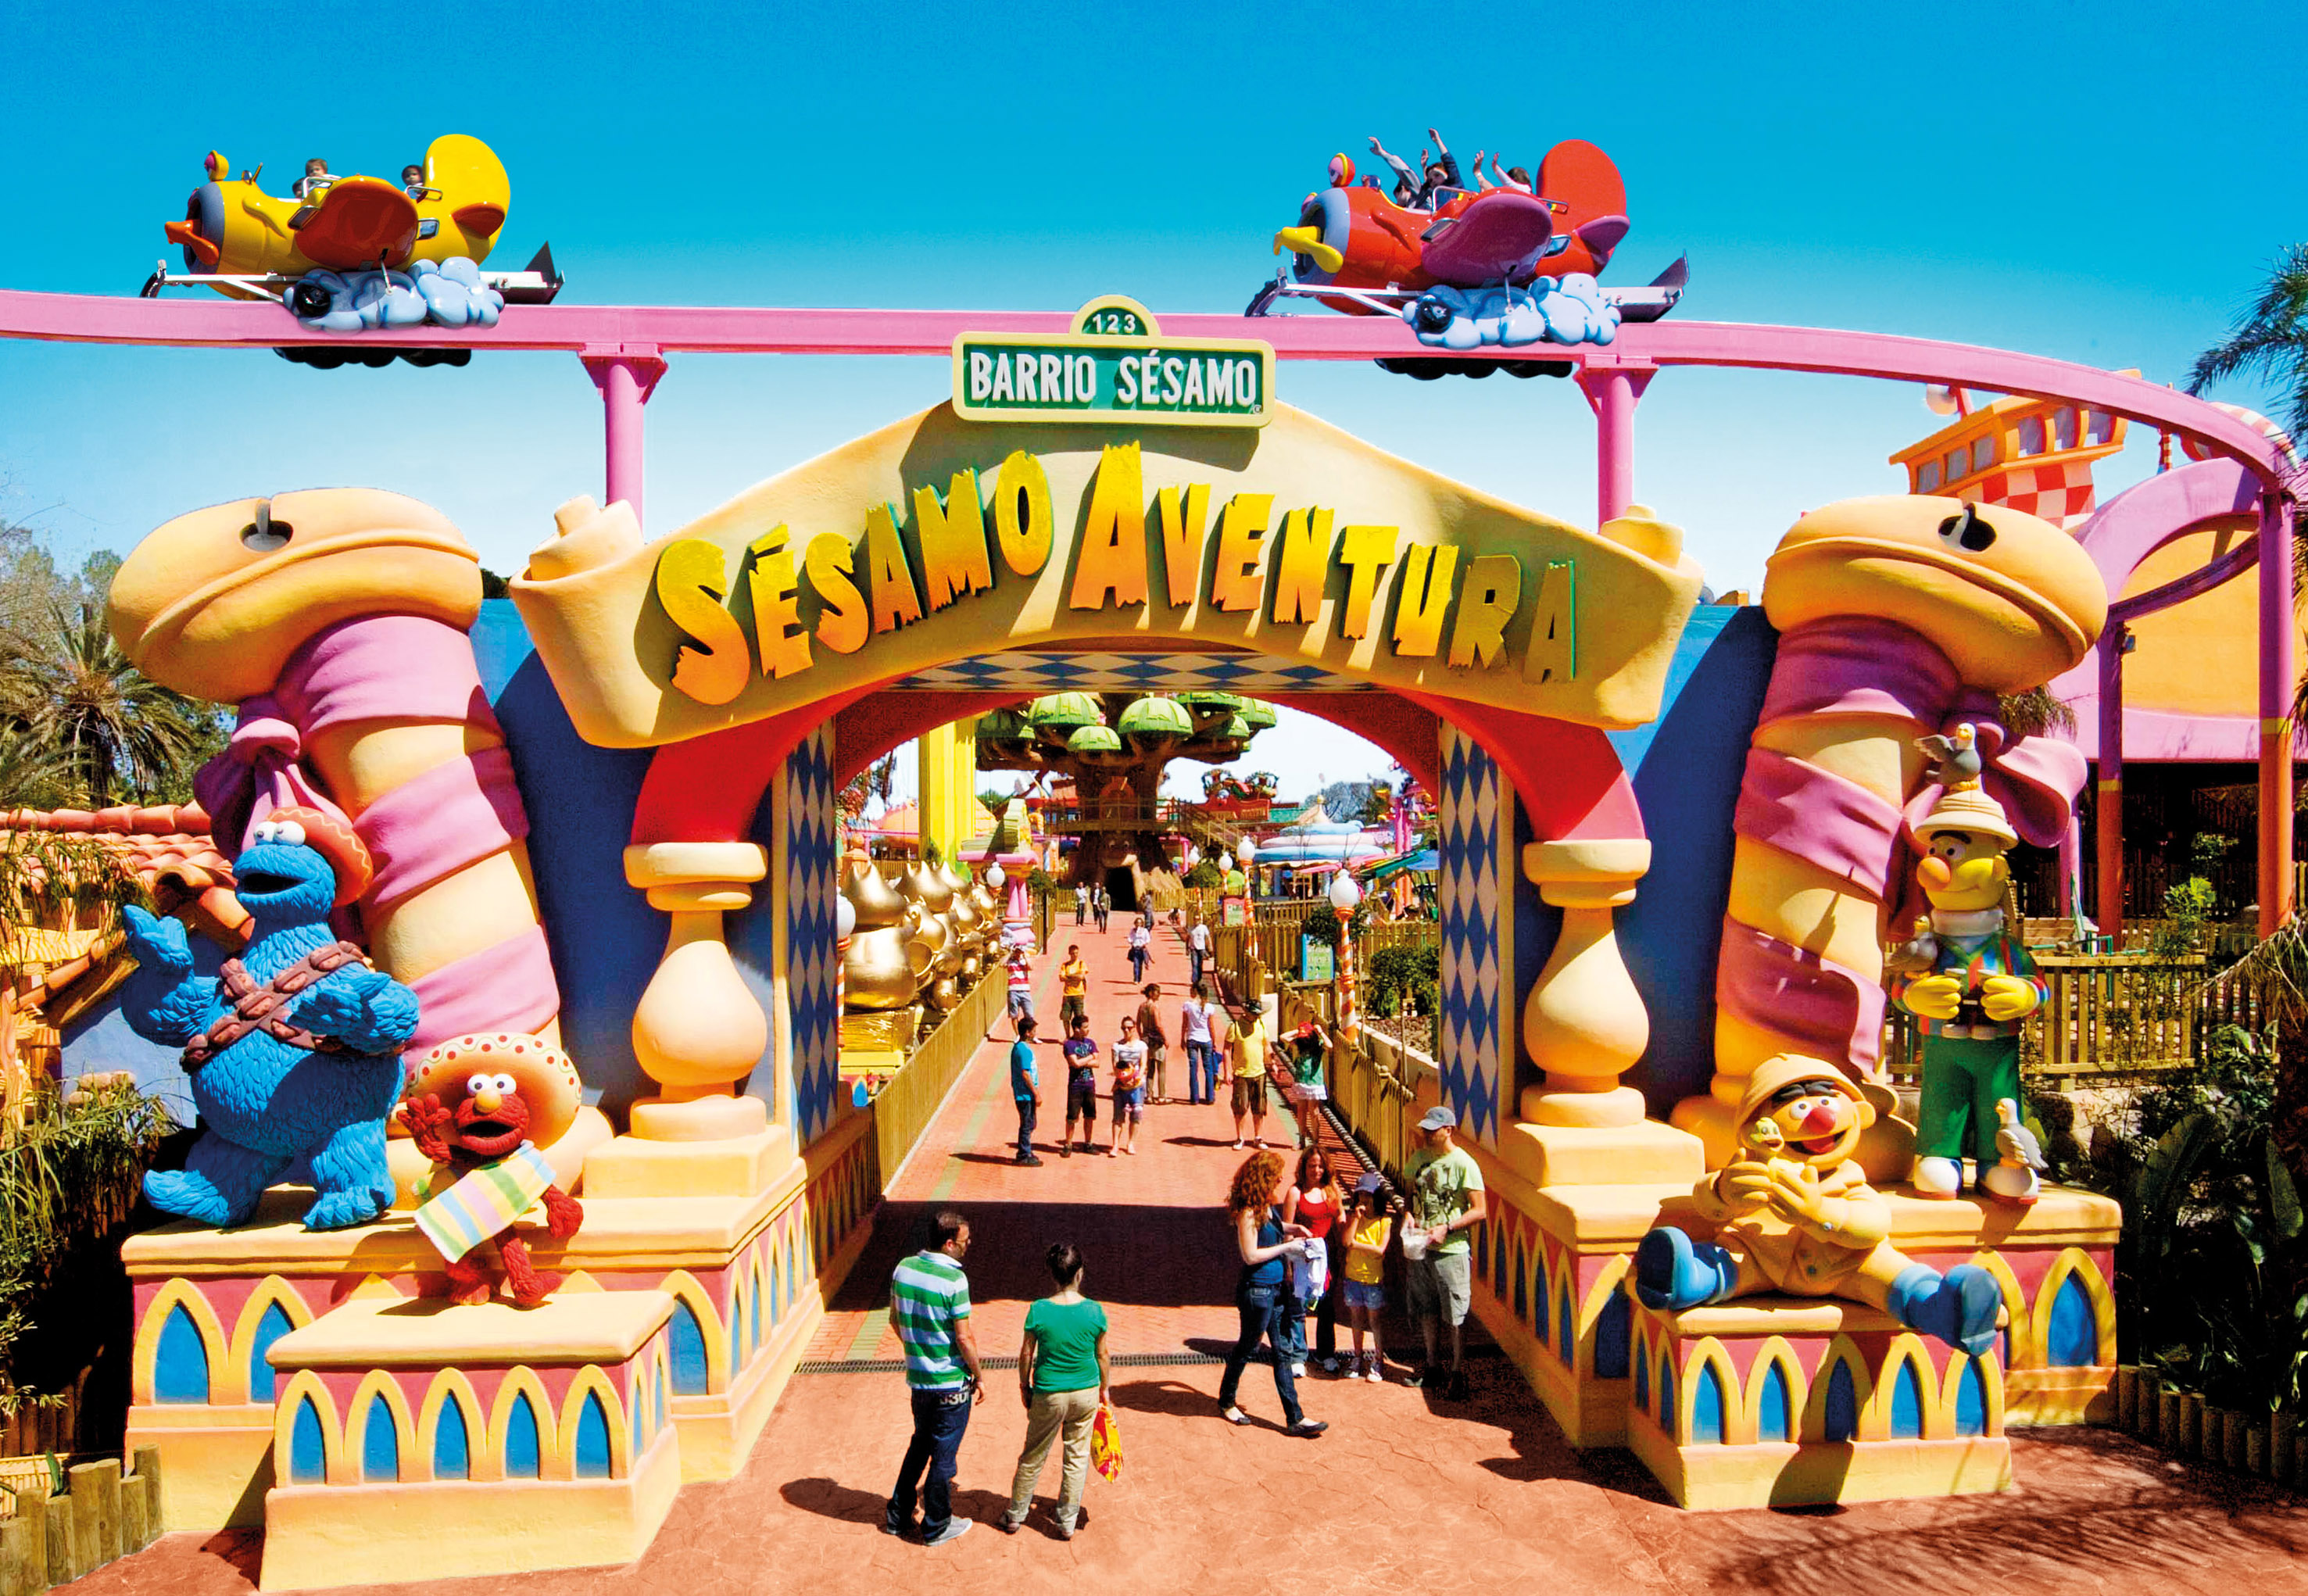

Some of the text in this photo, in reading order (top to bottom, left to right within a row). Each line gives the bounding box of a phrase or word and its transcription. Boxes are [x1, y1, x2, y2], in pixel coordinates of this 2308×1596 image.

[970, 349, 1257, 407] BARRIO SÉSAMO
[657, 439, 1576, 705] SÉSAMO AVENTURA
